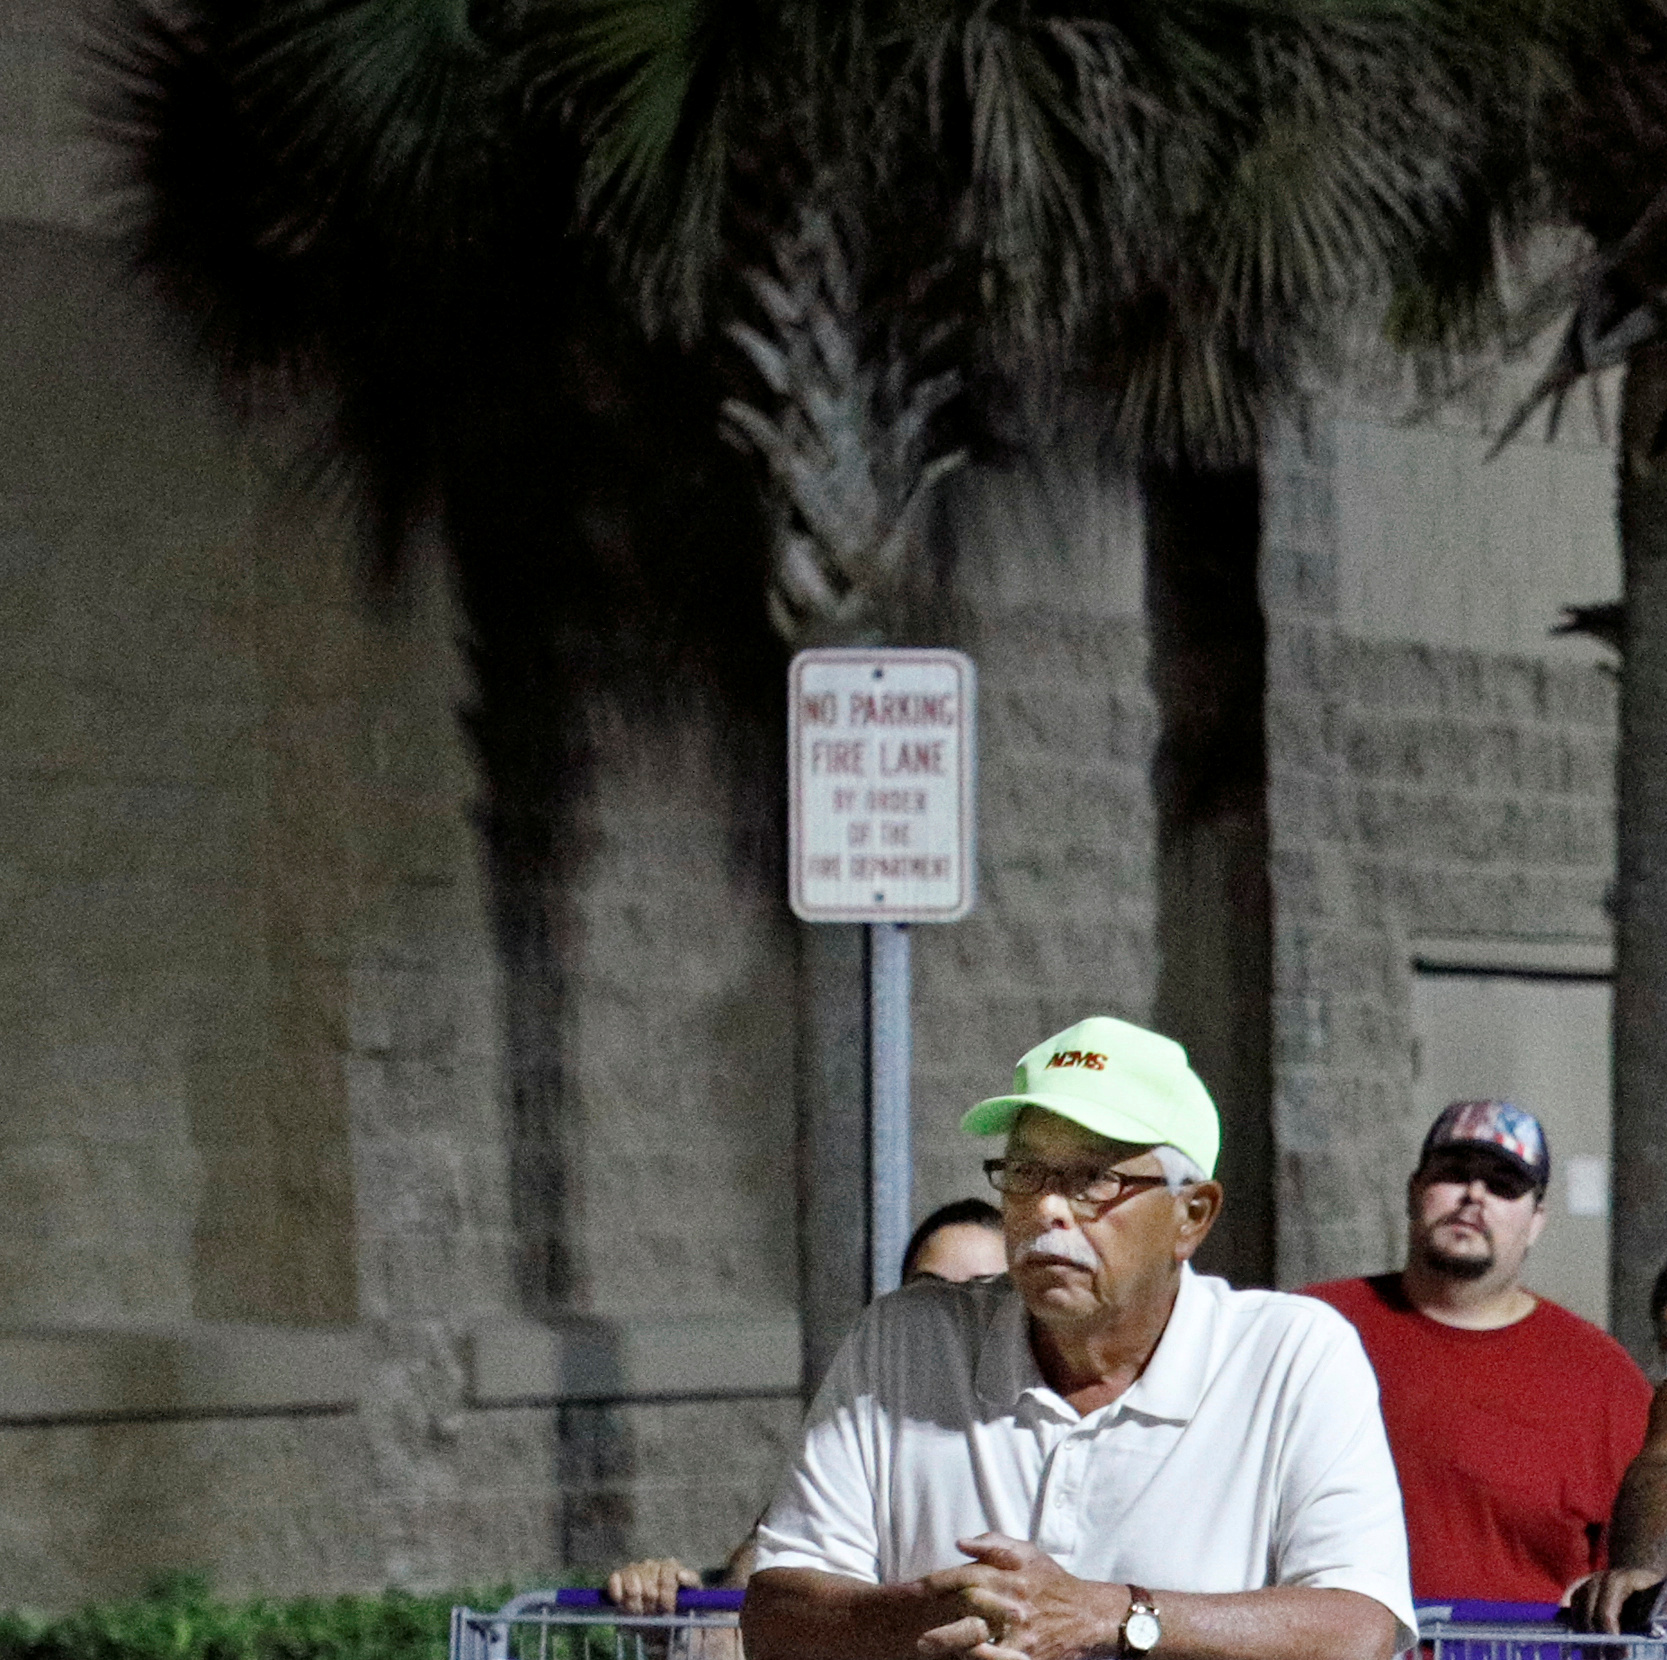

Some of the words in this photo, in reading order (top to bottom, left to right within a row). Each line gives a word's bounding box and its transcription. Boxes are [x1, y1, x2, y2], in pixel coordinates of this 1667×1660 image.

[801, 690, 837, 727] NO
[850, 688, 954, 728] PARKING
[811, 738, 865, 777] FIRE
[879, 739, 945, 777] LANE
